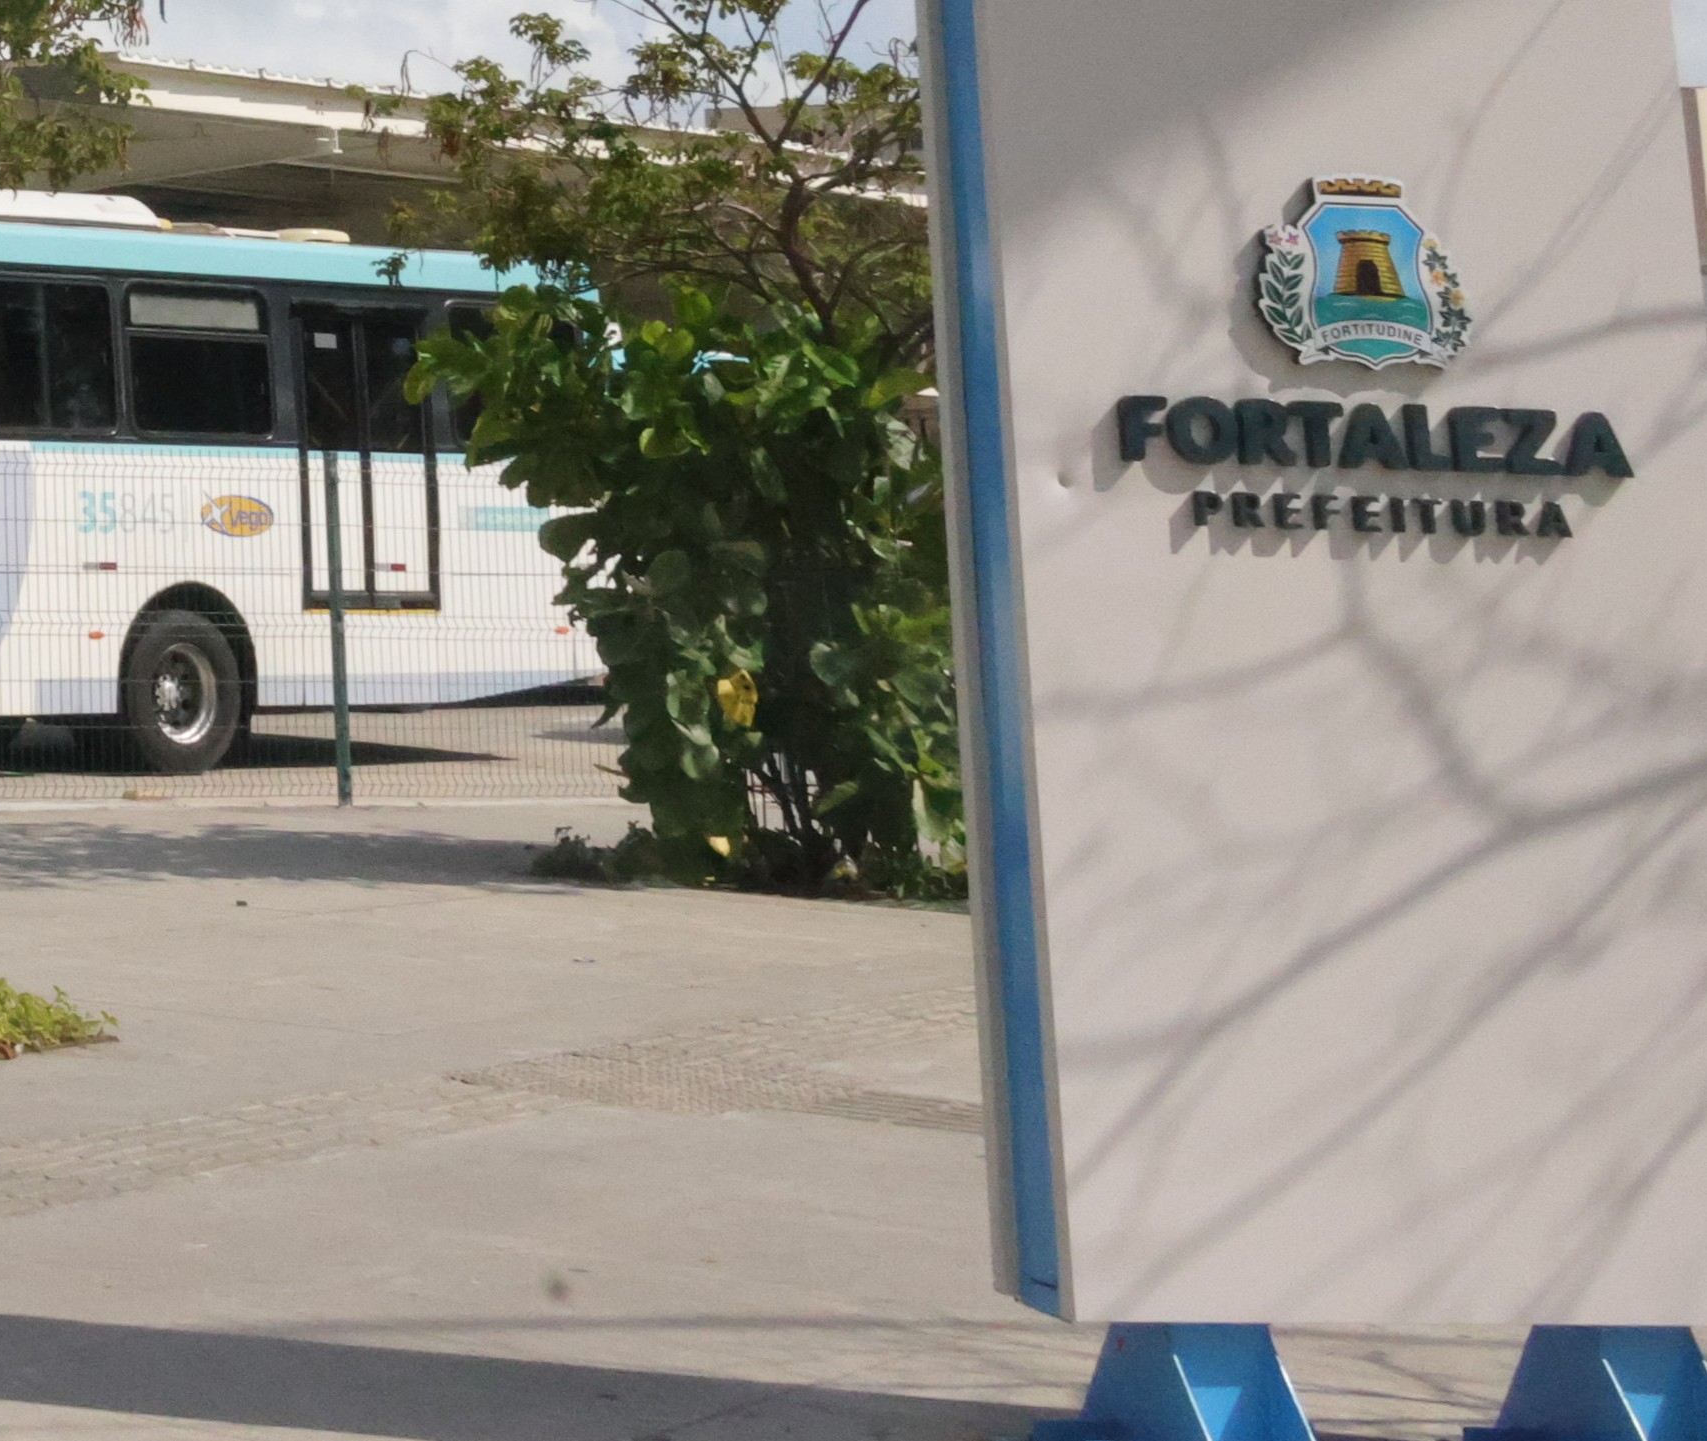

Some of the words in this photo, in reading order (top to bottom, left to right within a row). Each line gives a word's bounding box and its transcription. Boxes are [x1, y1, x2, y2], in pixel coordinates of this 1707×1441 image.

[1321, 323, 1424, 347] FORTITUDINE
[1116, 395, 1635, 478] FORTALEZA
[78, 491, 175, 533] 35845
[1192, 490, 1574, 539] PREFEITURA
